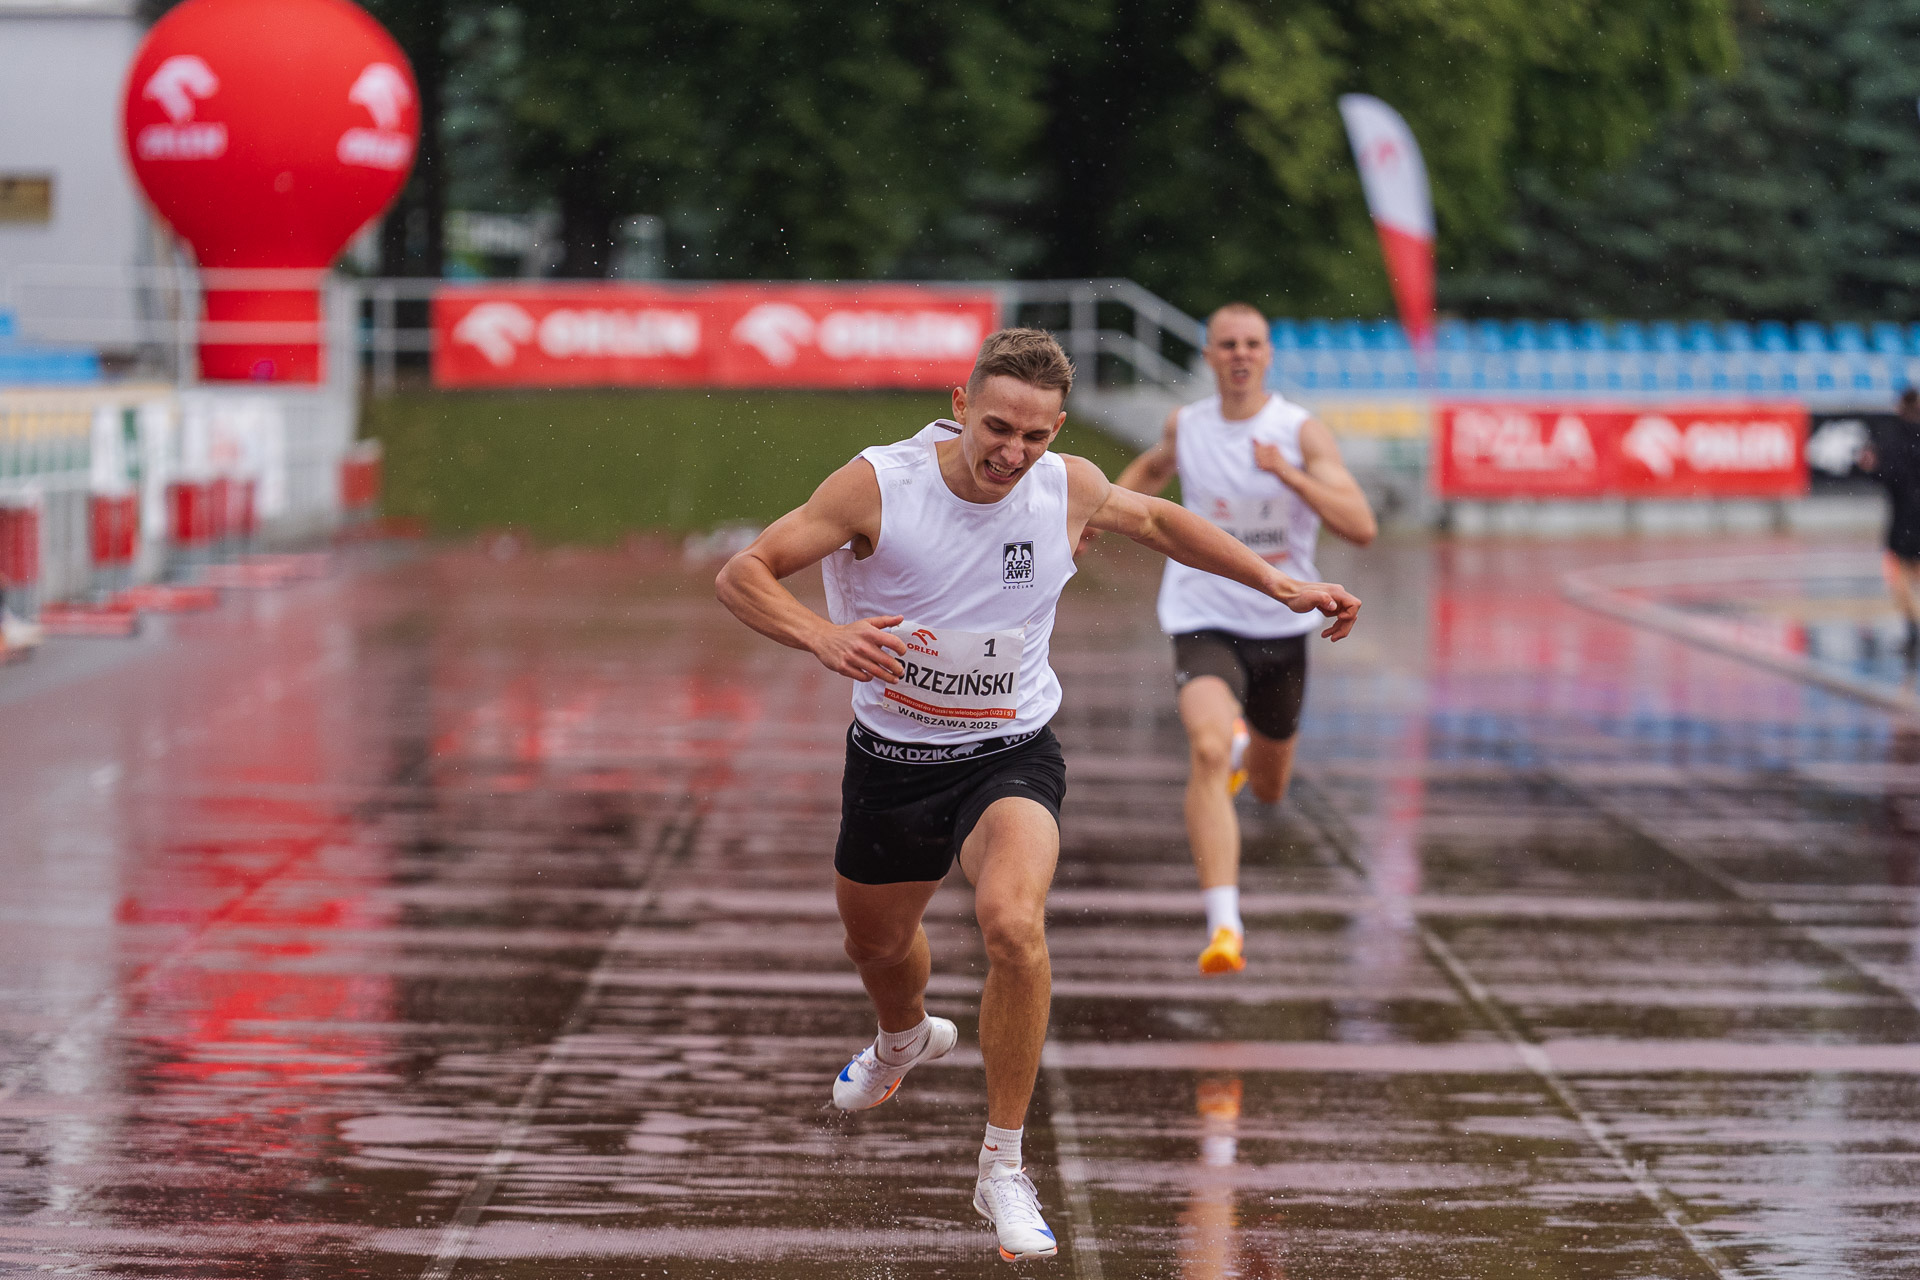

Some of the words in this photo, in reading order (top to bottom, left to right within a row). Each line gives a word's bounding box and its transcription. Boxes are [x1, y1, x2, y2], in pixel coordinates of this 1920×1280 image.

[1005, 560, 1031, 570] AZS
[1005, 569, 1032, 579] AWF
[907, 642, 939, 657] ORLEN
[983, 638, 997, 658] 1
[898, 705, 967, 728] WARSZAWA
[969, 721, 998, 730] 2025
